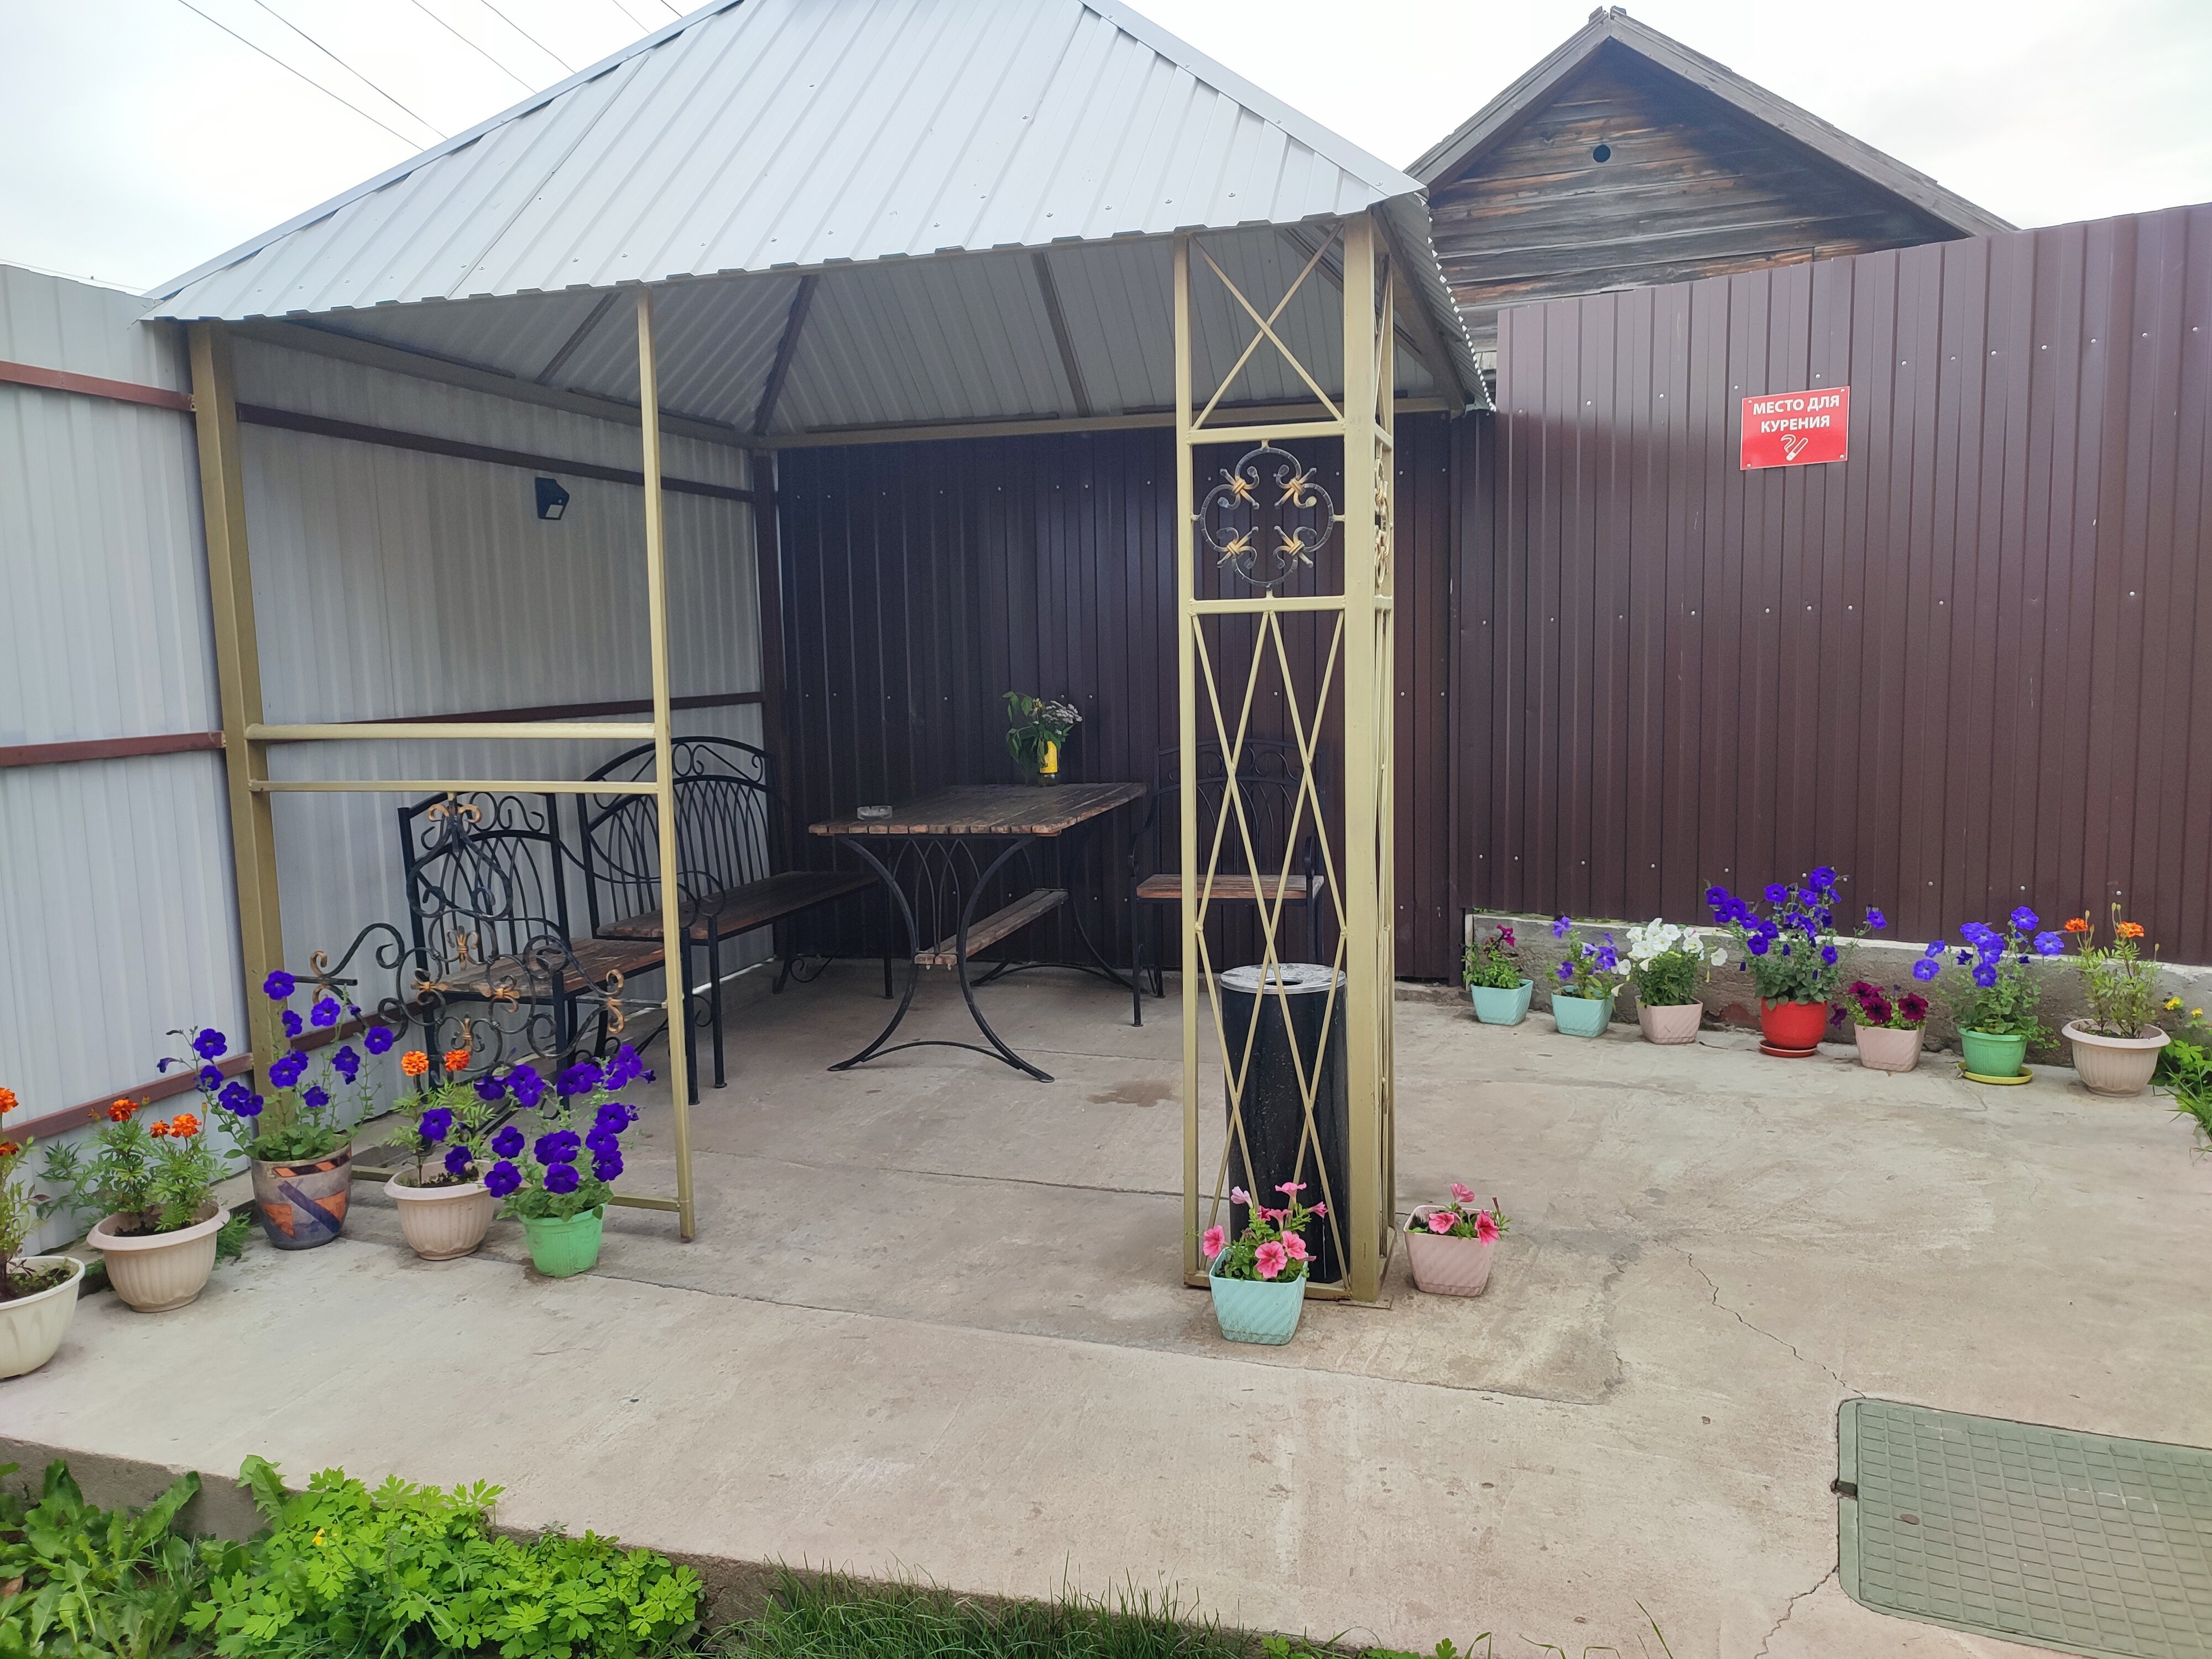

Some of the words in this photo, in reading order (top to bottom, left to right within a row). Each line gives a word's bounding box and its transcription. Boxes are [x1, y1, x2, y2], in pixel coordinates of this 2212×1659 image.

[1752, 399, 1804, 415] МЕСТО
[1807, 395, 1840, 412] ДЛЯ
[1761, 415, 1830, 433] КУРЕНИЯ
